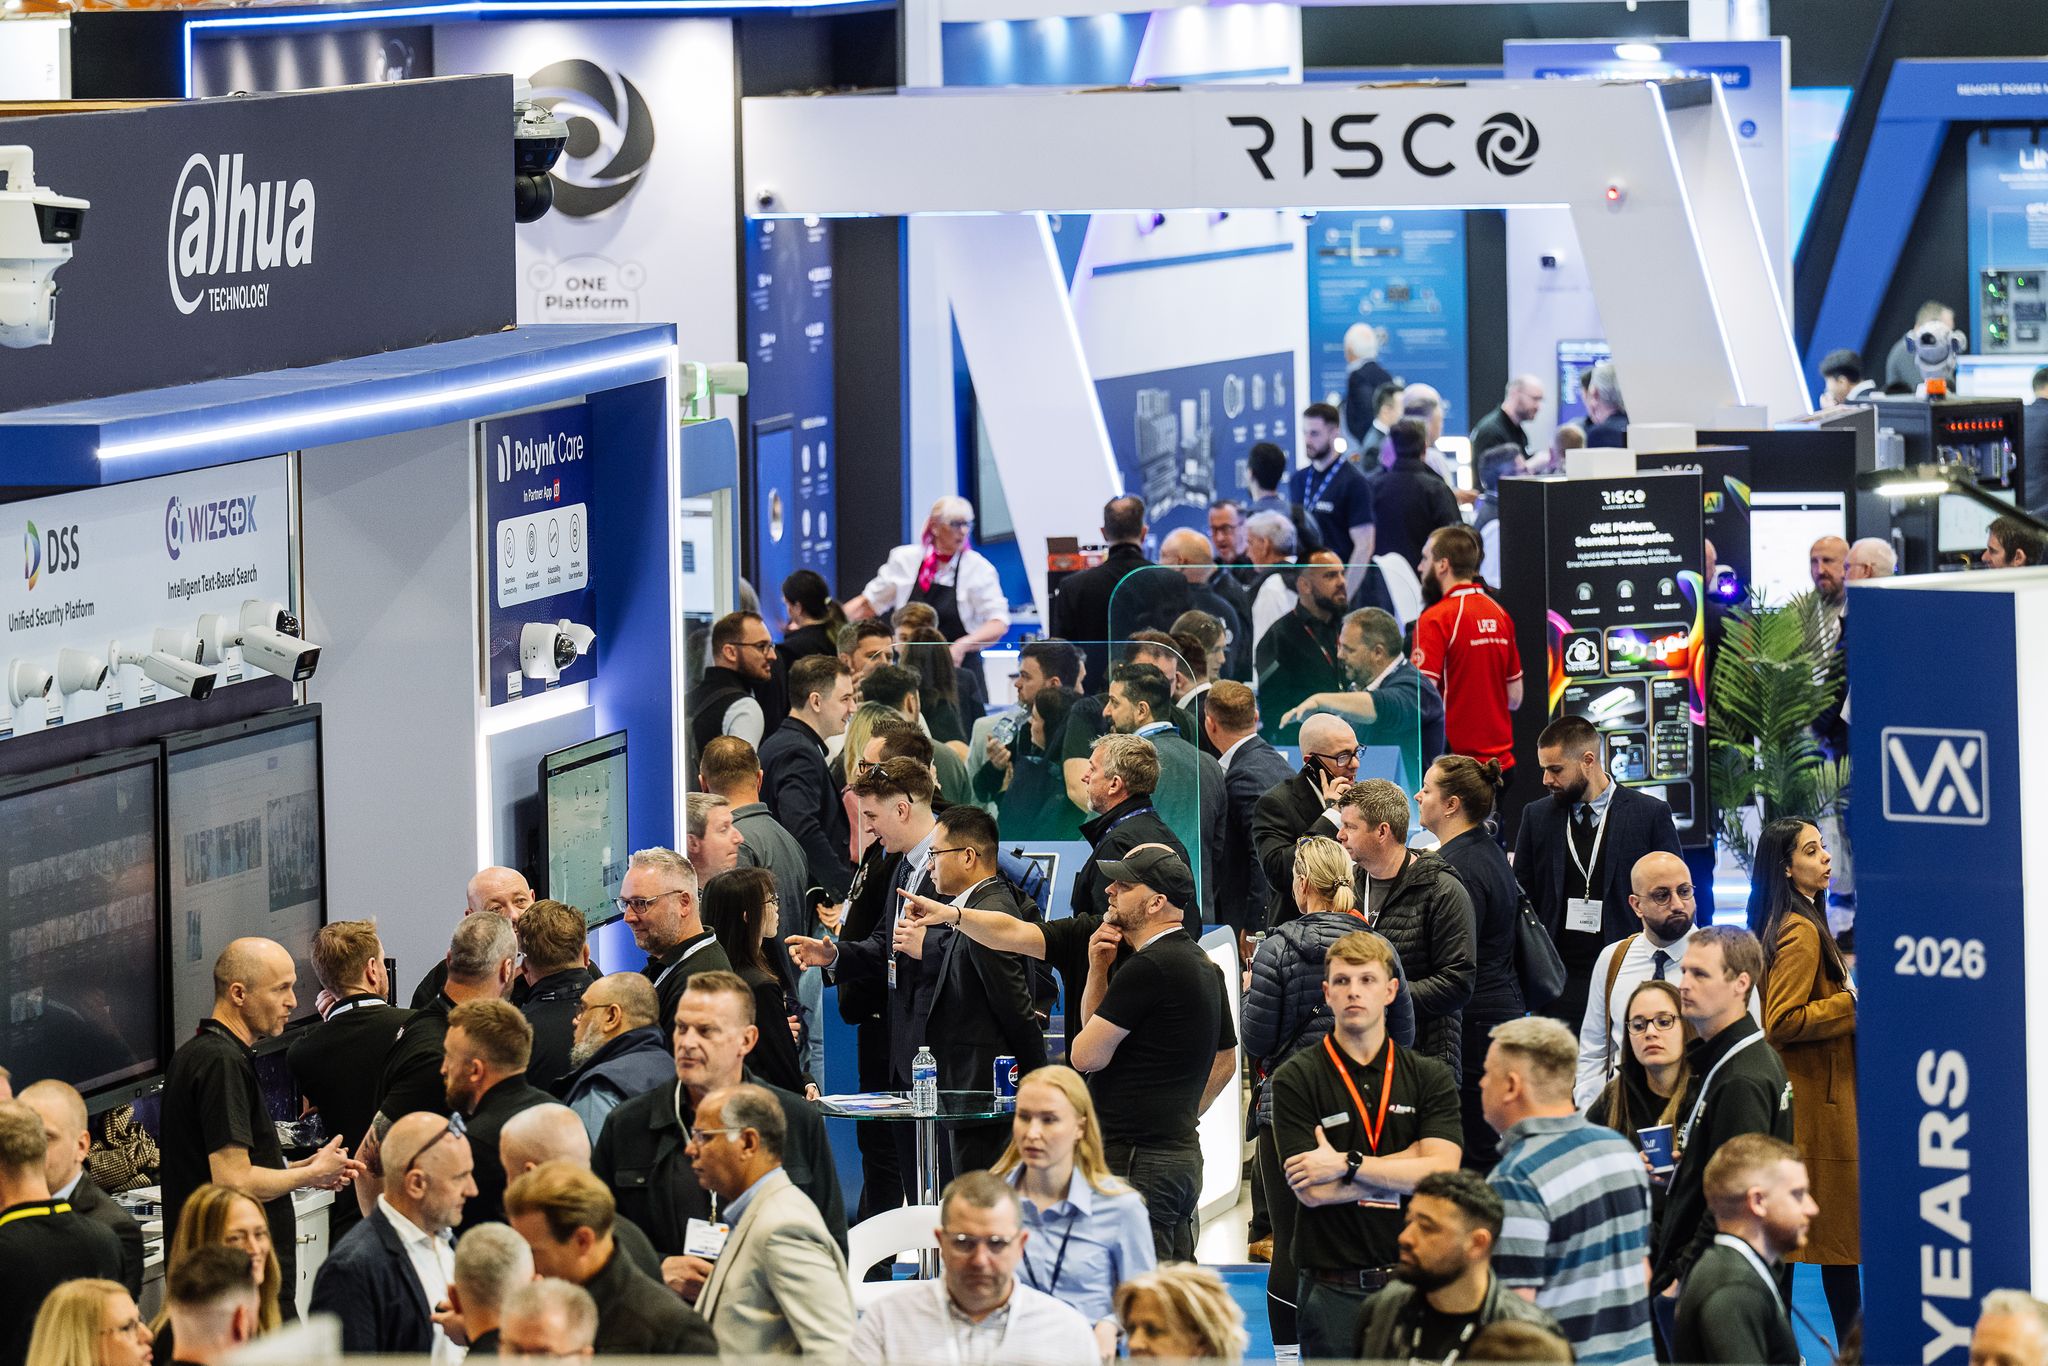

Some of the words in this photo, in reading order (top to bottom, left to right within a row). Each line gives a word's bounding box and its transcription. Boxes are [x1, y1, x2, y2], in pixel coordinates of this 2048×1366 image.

[1227, 112, 1541, 180] RISCO
[208, 283, 269, 313] TECHNOLOGY
[566, 277, 608, 292] ONE
[545, 295, 629, 310] Platform
[515, 434, 556, 475] DoLynk
[558, 432, 584, 463] Care
[528, 487, 543, 502] Partner
[544, 485, 552, 501] App
[1601, 489, 1646, 505] RISCO
[47, 525, 80, 575] DSS
[168, 577, 201, 601] Intelligent
[201, 570, 236, 593] Text-Based
[236, 564, 257, 586] Search
[9, 610, 35, 632] Unified
[35, 604, 64, 628] Security
[65, 600, 95, 621] Platform
[1894, 935, 1986, 980] 2026
[1916, 1048, 1973, 1366] YEARS
